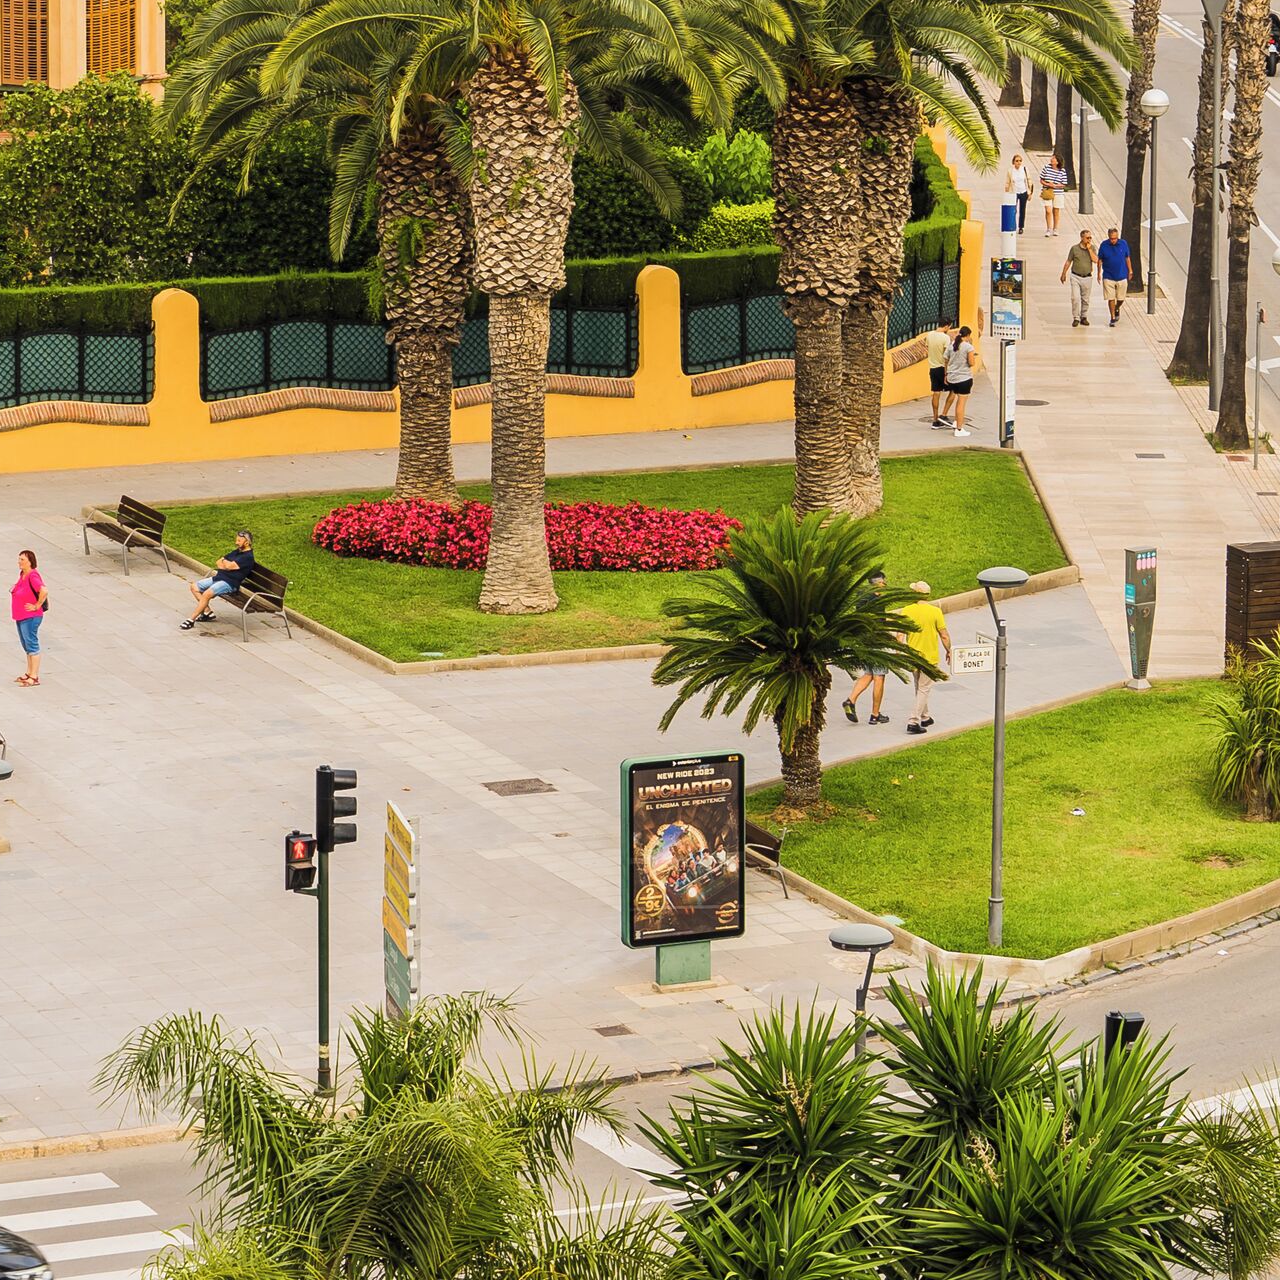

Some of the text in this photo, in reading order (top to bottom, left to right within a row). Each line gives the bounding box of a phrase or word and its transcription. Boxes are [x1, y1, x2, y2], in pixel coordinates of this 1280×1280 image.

[996, 260, 1002, 271] 3
[963, 660, 984, 668] BONET
[657, 768, 715, 780] NEW RIDE 2023
[638, 778, 732, 800] UNCHARTED
[692, 797, 726, 805] PENITENCE
[646, 887, 655, 897] 2
